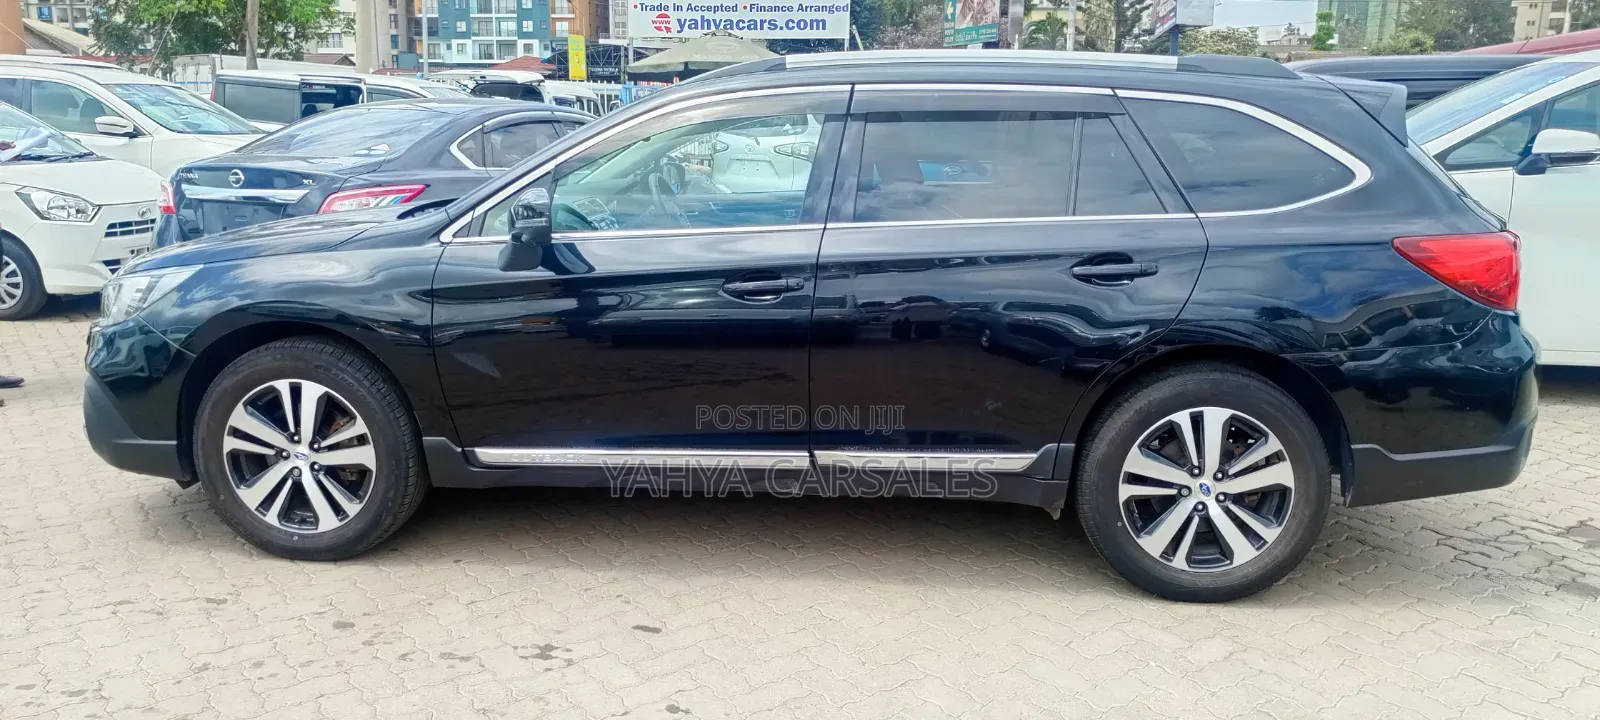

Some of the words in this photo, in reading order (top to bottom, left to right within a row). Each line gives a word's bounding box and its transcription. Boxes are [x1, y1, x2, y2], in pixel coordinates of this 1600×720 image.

[639, 3, 669, 12] Trade
[673, 3, 683, 12] In
[686, 3, 738, 14] Accepted
[749, 3, 794, 12] Finance
[797, 3, 849, 14] Arranged
